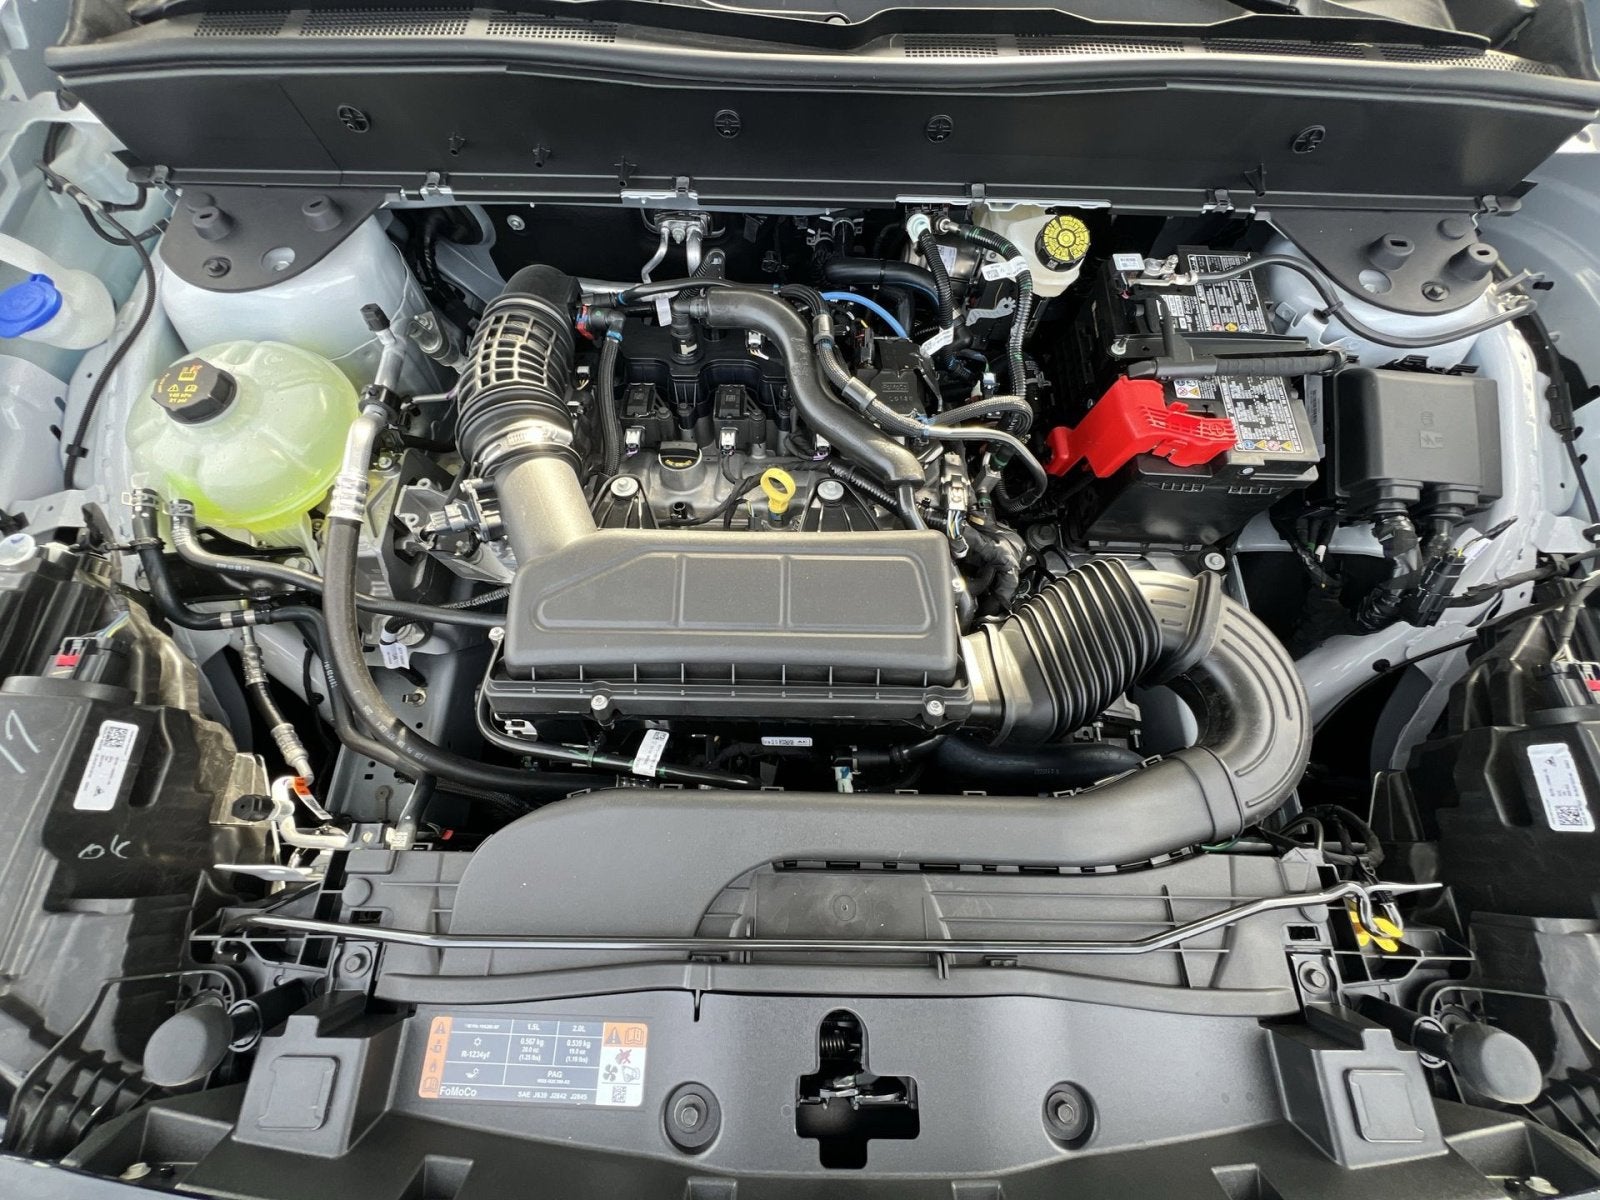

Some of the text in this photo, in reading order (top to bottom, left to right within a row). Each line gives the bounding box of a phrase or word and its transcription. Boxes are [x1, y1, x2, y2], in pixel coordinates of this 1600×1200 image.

[536, 1038, 544, 1047] kg
[582, 1040, 591, 1049] kg
[461, 1050, 490, 1059] R-1234yf
[547, 1070, 563, 1078] PAG
[439, 1086, 477, 1098] FoMoCo
[517, 1090, 531, 1099] SAE
